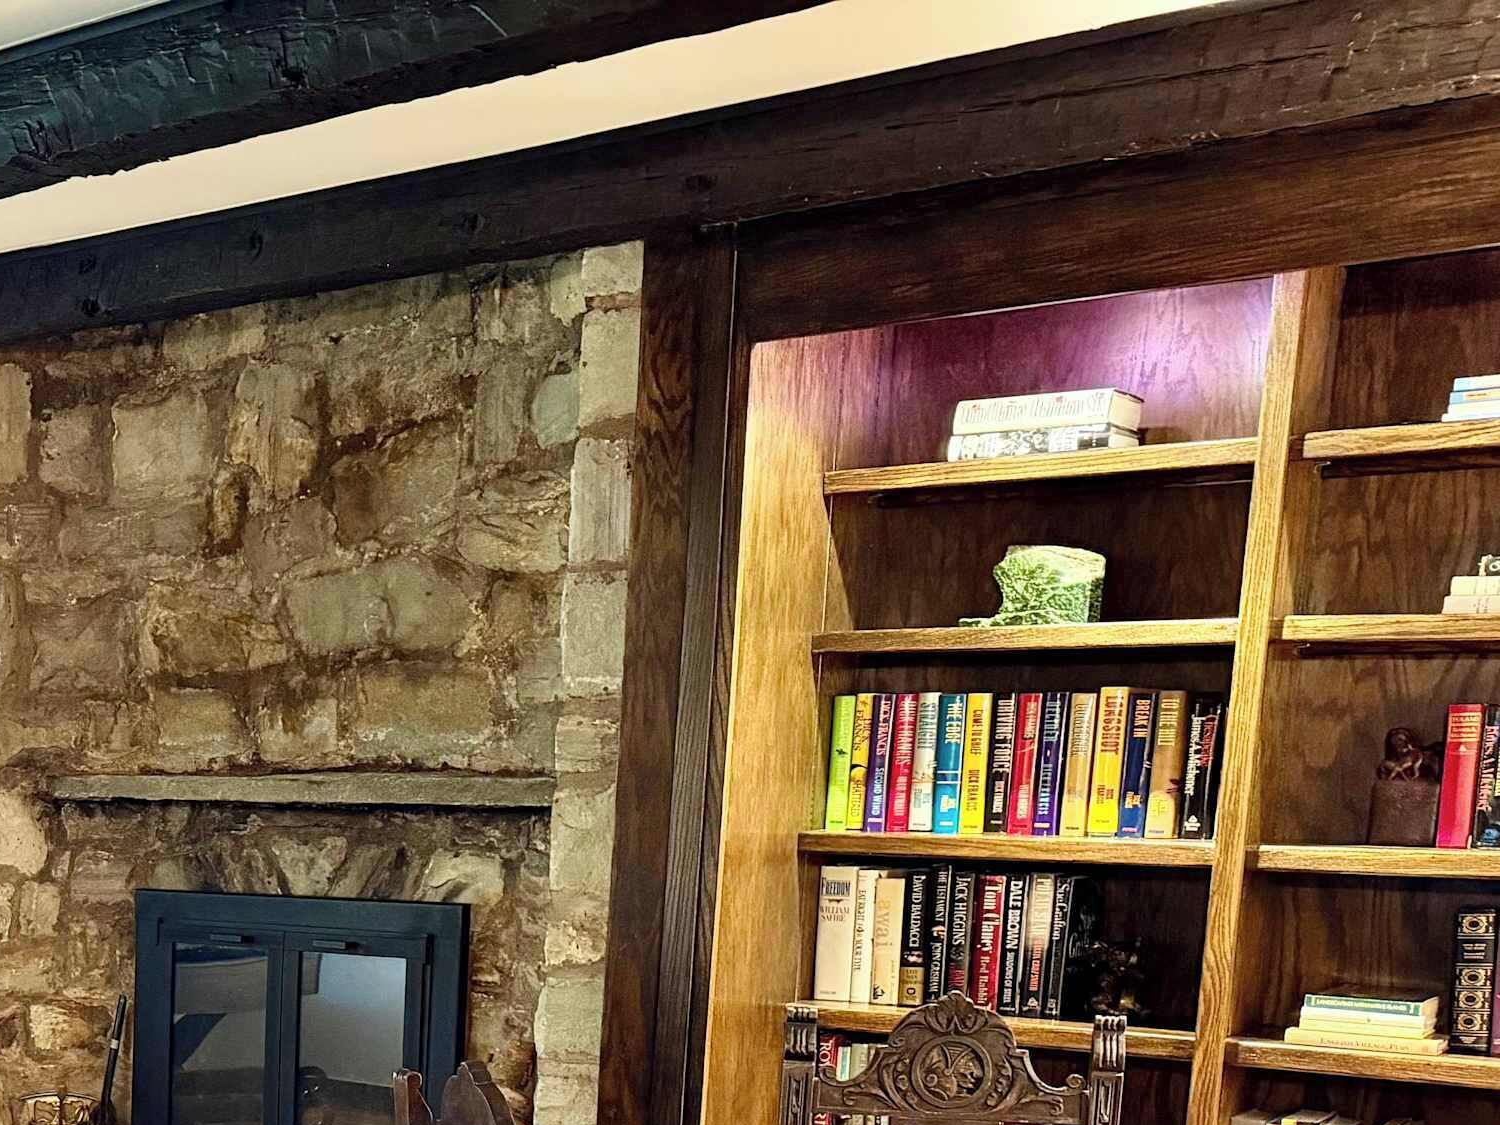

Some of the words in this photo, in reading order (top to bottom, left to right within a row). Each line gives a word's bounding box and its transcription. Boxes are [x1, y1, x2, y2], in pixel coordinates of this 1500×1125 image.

[1133, 699, 1151, 727] BREAK
[1160, 698, 1180, 709] TO
[916, 702, 937, 750] STRAIGHT
[944, 721, 961, 744] EDGE
[972, 709, 984, 729] COME
[994, 699, 1015, 740] DRIVING
[1043, 701, 1061, 741] DECIDER
[1100, 695, 1124, 755] LONGSHOT
[1132, 727, 1148, 738] IN
[1159, 711, 1179, 728] THE
[1190, 714, 1206, 741] James
[876, 722, 888, 756] FRANCIS
[969, 737, 982, 756] GRIEF
[1156, 728, 1177, 746] HILT
[1200, 714, 1218, 768] Chesapeake
[992, 743, 1012, 773] FORCE
[873, 767, 885, 794] SECOND
[968, 769, 981, 784] DICK
[1184, 751, 1201, 796] Michener
[850, 779, 862, 817] SHATTERED
[871, 794, 883, 816] WIND
[966, 784, 980, 812] FRANCIS
[1037, 781, 1051, 815] FRANCIS
[821, 877, 851, 897] FREEDOM
[912, 875, 926, 903] DAVID
[954, 876, 971, 902] JACK
[983, 883, 1003, 910] Tom
[1008, 880, 1023, 909] DALE
[1056, 883, 1070, 902] Sue
[819, 905, 850, 914] WILLIAM
[934, 885, 947, 921] TESTAMENT
[908, 903, 922, 948] BALDACCI
[952, 902, 967, 945] HIGGINS
[978, 912, 1001, 953] Clancy
[1005, 909, 1021, 949] BROWN
[1051, 902, 1068, 940] Grafton
[930, 942, 942, 961] JOHN
[979, 956, 990, 973] Red
[1004, 951, 1015, 979] SHADOWS
[928, 961, 940, 993] GRISHAM
[976, 975, 989, 1004] Rabbit
[1029, 974, 1040, 991] SMITH
